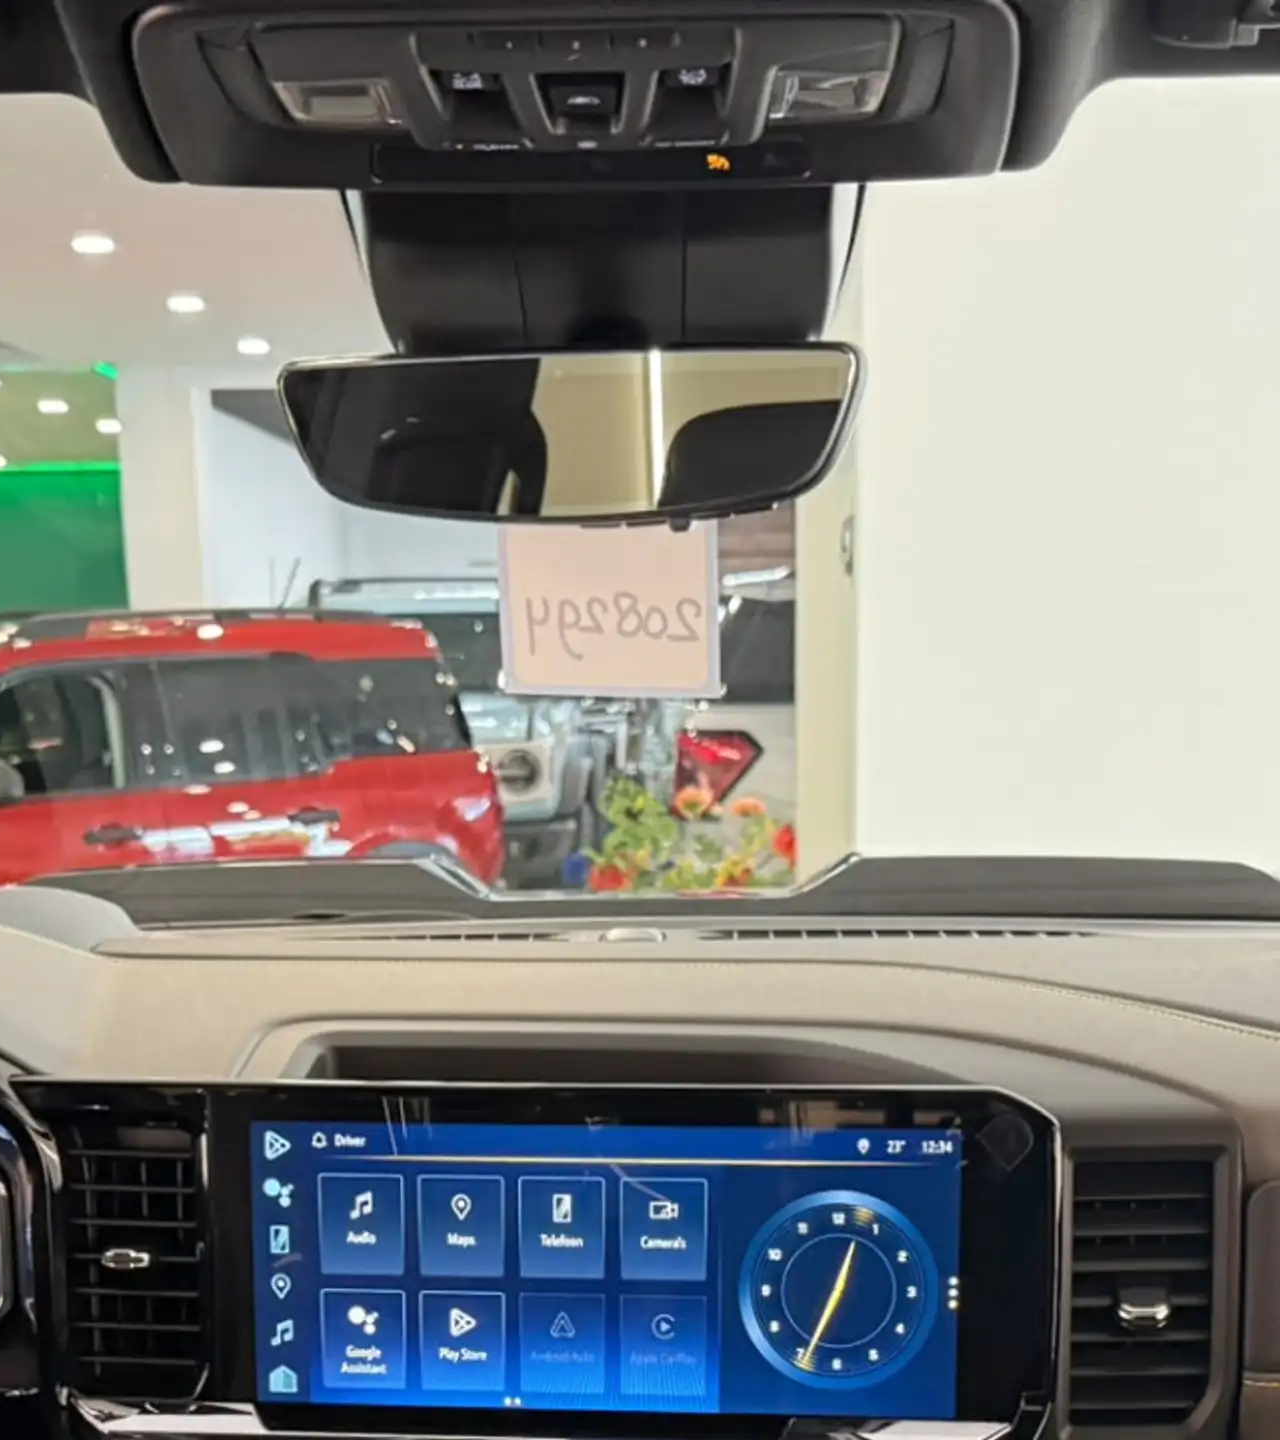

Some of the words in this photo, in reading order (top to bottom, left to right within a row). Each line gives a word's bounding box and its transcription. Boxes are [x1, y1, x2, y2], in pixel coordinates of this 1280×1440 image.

[334, 1133, 367, 1147] Driver
[922, 1140, 953, 1153] 12:34
[873, 1224, 879, 1235] 1
[346, 1231, 376, 1244] Audio
[447, 1232, 477, 1247] Maps
[540, 1233, 583, 1248] Telefoon
[640, 1235, 686, 1249] Camera's
[897, 1251, 907, 1262] 2
[907, 1286, 917, 1298] 3
[895, 1322, 905, 1334] 4
[346, 1345, 381, 1360] Google
[439, 1347, 458, 1363] Play
[460, 1348, 487, 1361] Store
[340, 1361, 387, 1375] Assistant
